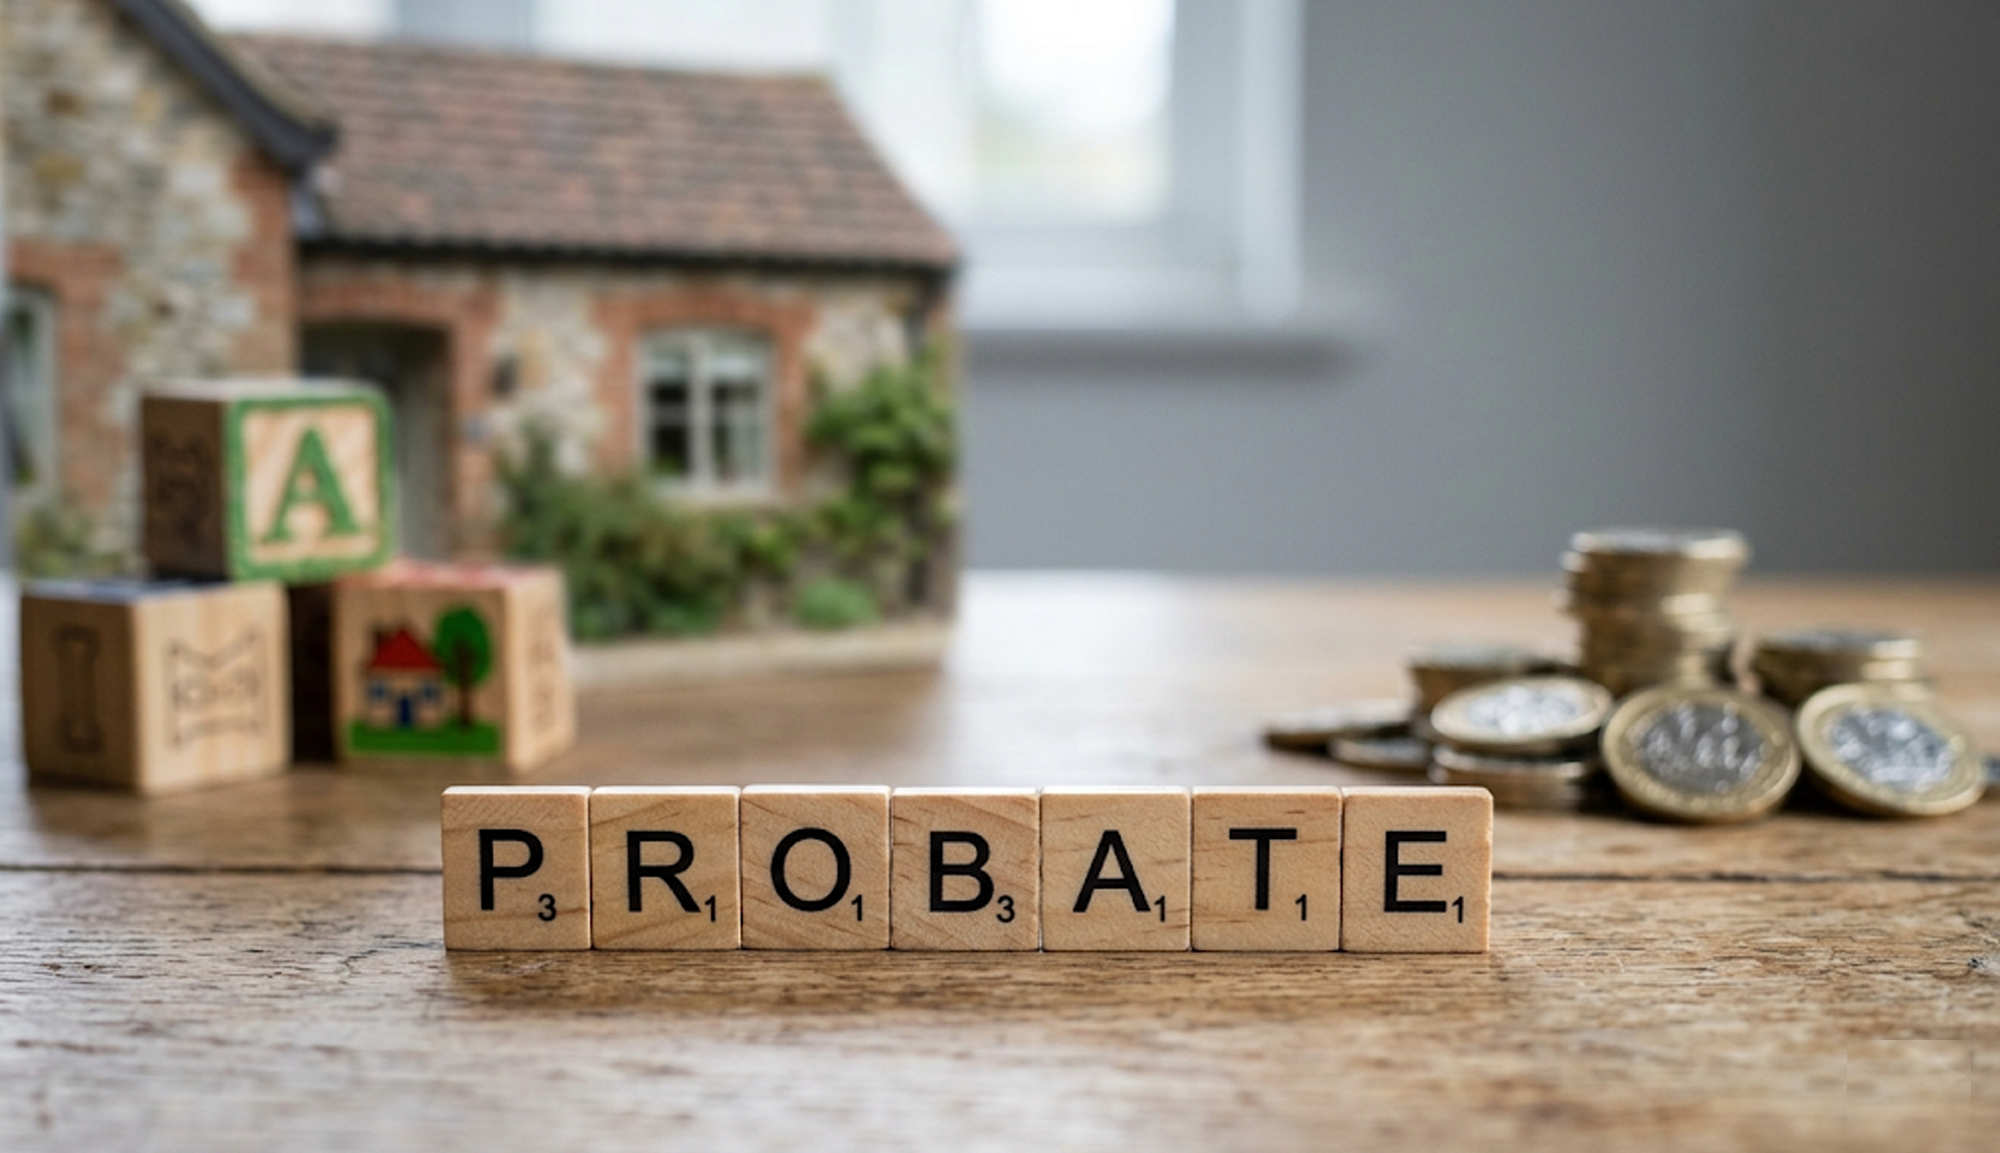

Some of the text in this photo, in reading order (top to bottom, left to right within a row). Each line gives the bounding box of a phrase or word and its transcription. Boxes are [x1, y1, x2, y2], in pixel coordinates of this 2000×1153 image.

[259, 427, 363, 543] A
[478, 827, 1448, 914] PROBATE
[537, 893, 1464, 924] 3 1 1 3 1 1 1
